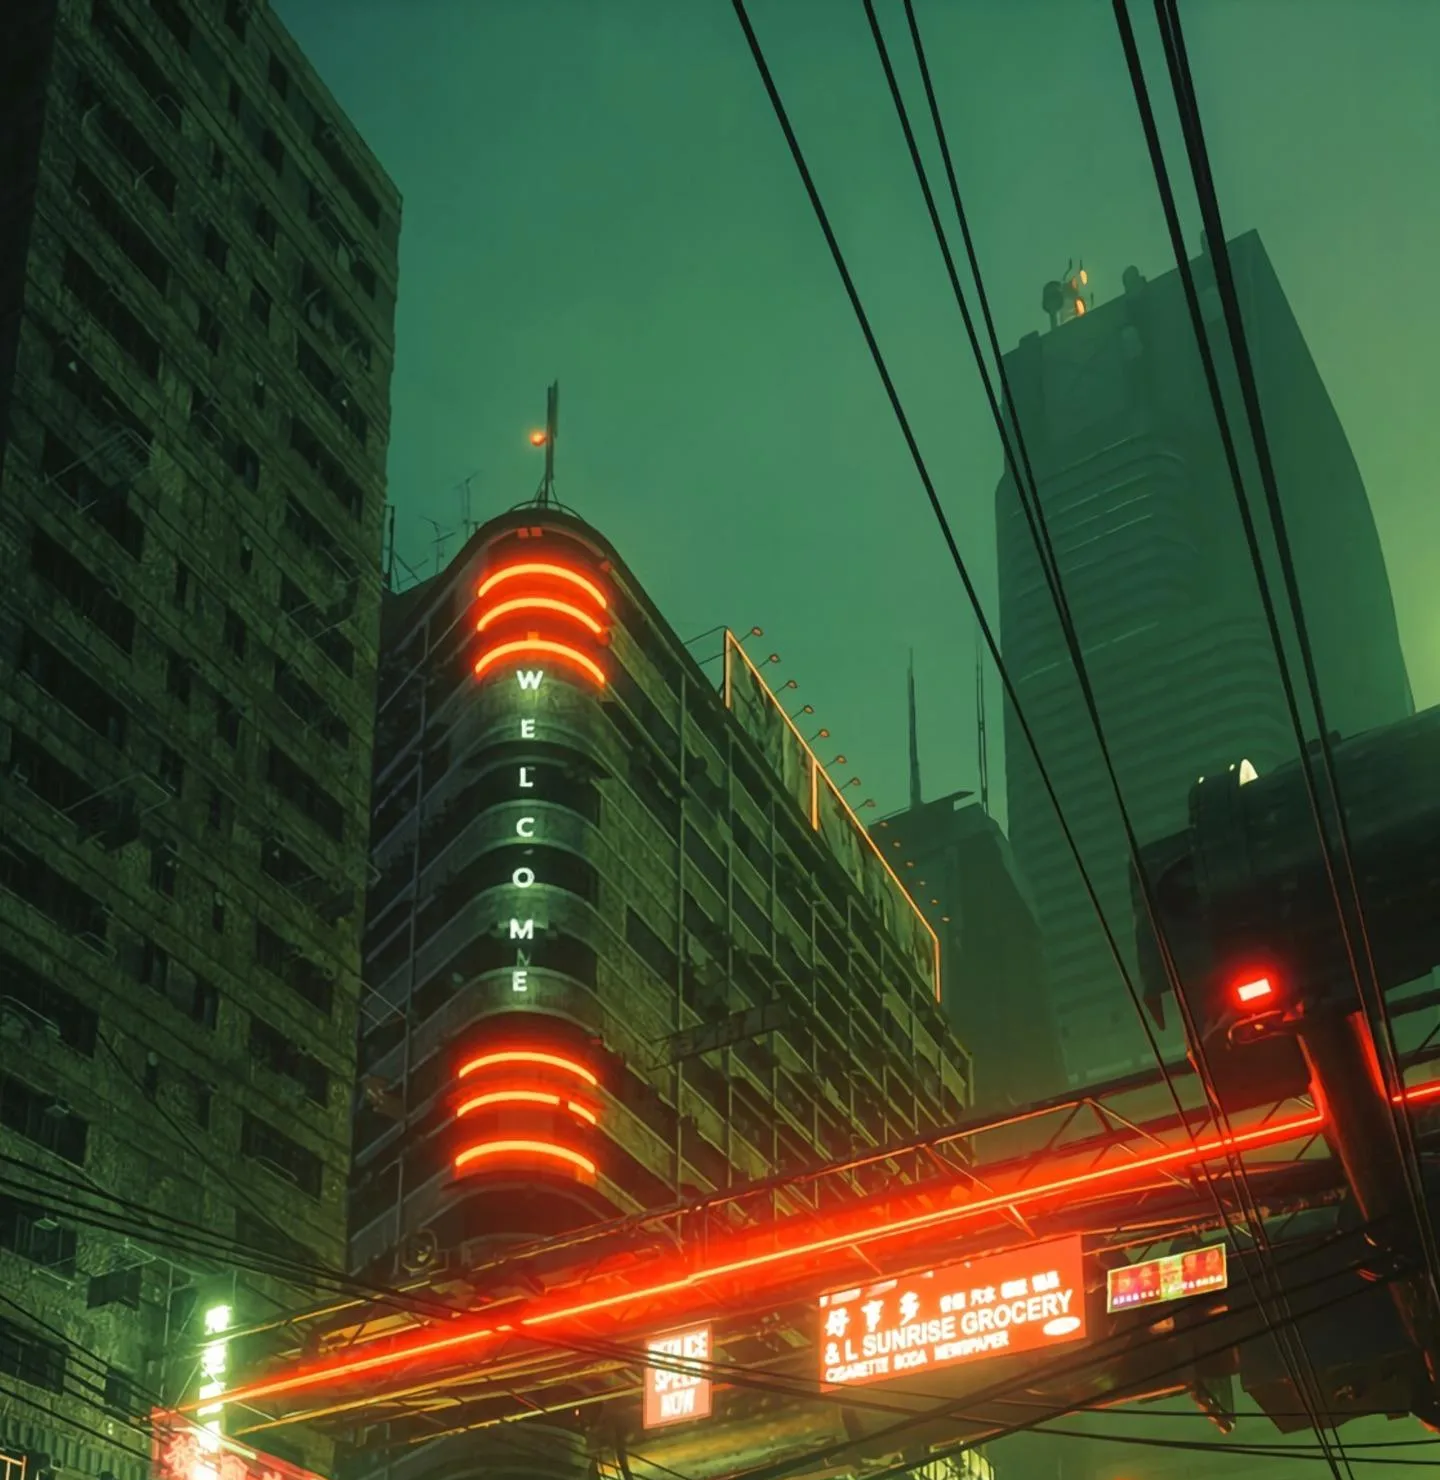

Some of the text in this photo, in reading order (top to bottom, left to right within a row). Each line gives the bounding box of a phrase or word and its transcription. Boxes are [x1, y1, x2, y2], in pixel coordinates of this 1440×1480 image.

[509, 669, 543, 992] WELCOME
[825, 1342, 840, 1366] &
[845, 1339, 859, 1362] L
[862, 1315, 957, 1357] SUNRISE
[960, 1289, 1073, 1336] GROCERY
